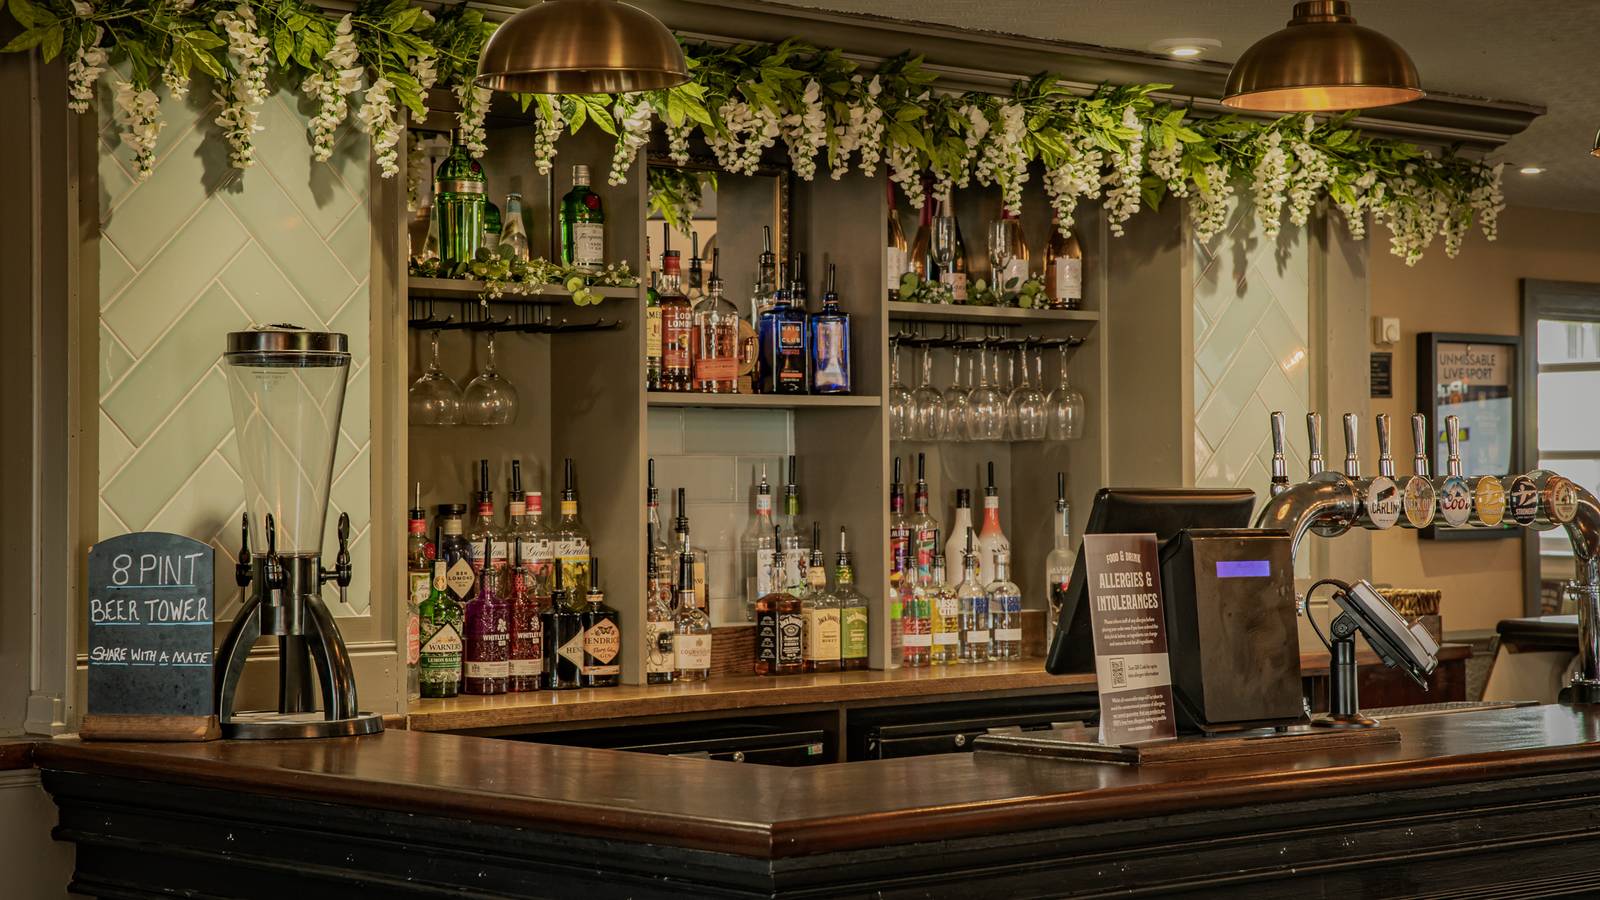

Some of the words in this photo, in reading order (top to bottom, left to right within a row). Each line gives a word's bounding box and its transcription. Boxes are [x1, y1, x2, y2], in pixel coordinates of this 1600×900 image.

[1439, 352, 1496, 366] UNMISSABLE
[1443, 368, 1463, 379] LIVE
[1371, 502, 1399, 514] CARLIN
[1106, 552, 1119, 564] FOOD
[1119, 550, 1125, 562] &
[1125, 551, 1141, 563] DRINK
[112, 554, 132, 585] 8
[139, 553, 204, 585] PINT
[1099, 571, 1144, 589] ALLERGIES
[1145, 571, 1153, 587] &
[90, 599, 140, 622] BEER
[144, 597, 209, 622] TOWER
[1096, 593, 1159, 611] INTOLERANCES
[90, 646, 128, 661] SHARE
[131, 649, 156, 662] WITH
[159, 651, 170, 663] A
[172, 651, 211, 664] MATE
